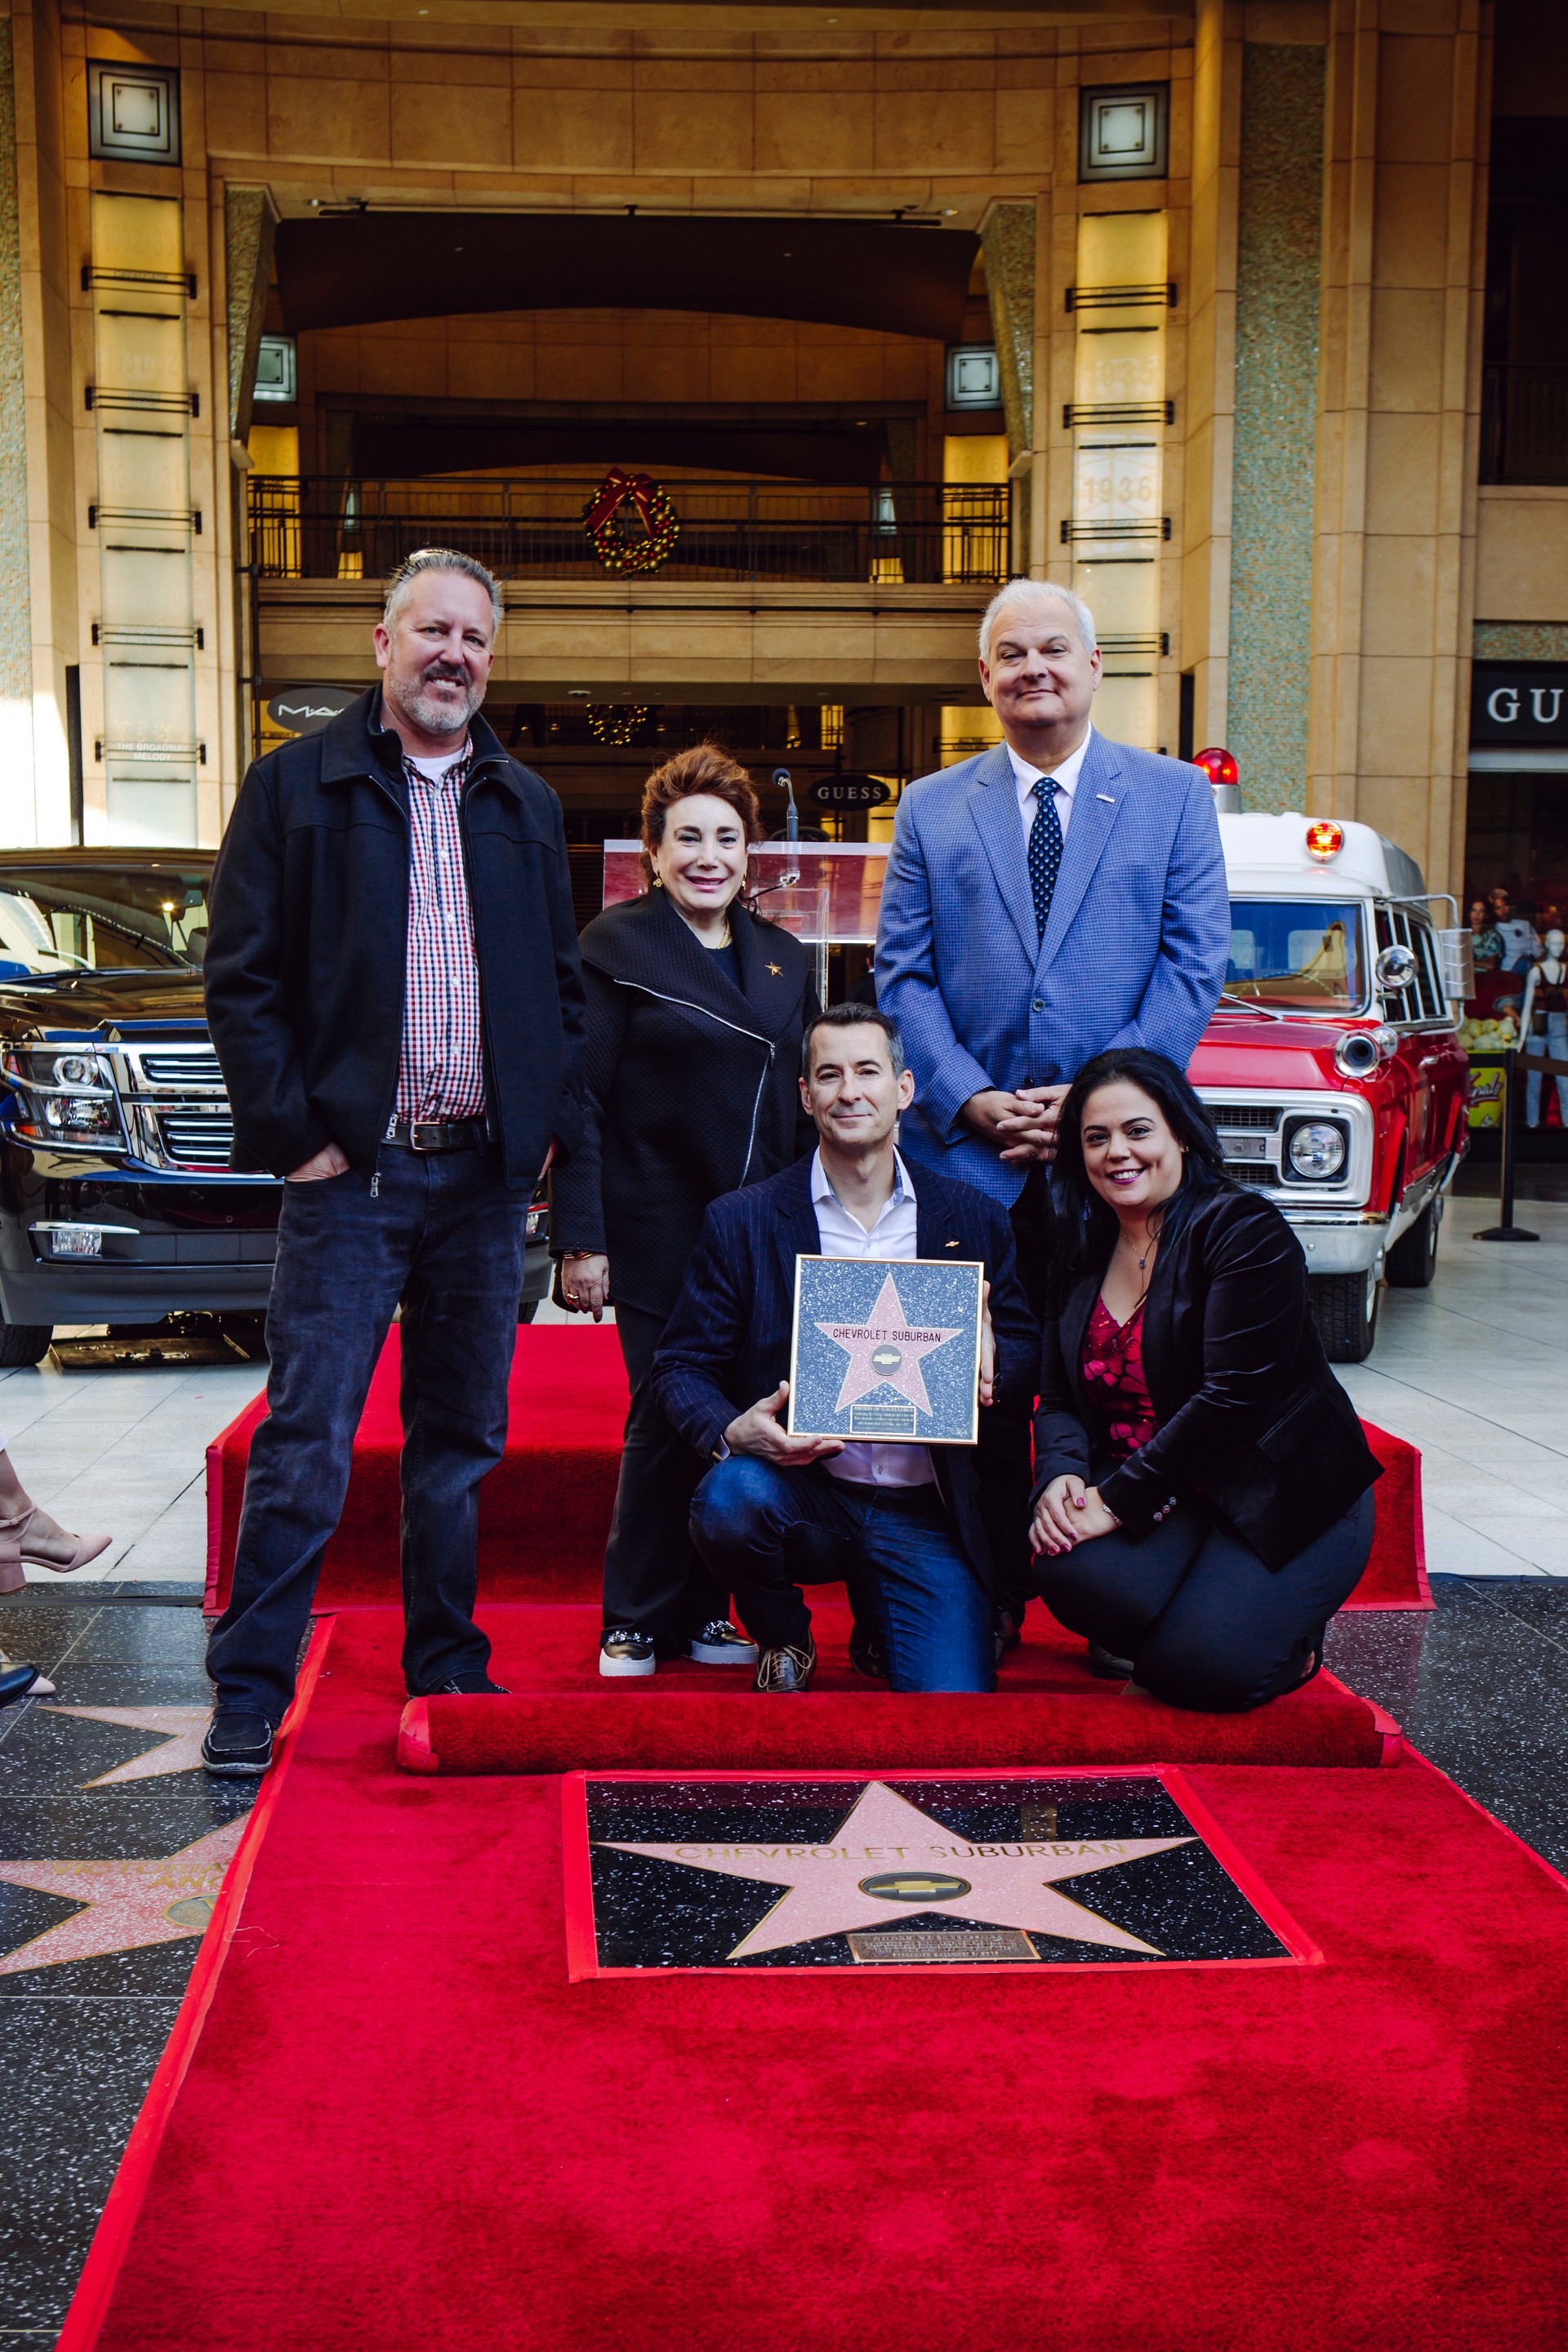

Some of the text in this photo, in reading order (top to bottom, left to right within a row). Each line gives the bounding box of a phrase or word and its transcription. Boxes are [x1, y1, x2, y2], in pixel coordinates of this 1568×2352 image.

[1086, 359, 1156, 389] 1935
[252, 447, 292, 467] 945
[952, 455, 1001, 476] 1946
[1083, 476, 1152, 504] 1936
[1487, 688, 1565, 724] GU
[117, 742, 188, 752] THE BROADWAY
[133, 752, 172, 761] MELODY
[817, 786, 882, 800] GUESS
[833, 1329, 941, 1343] CHEVROLET SUBURBAN
[675, 1844, 1128, 1860] CHEVROLET SUBURBAN
